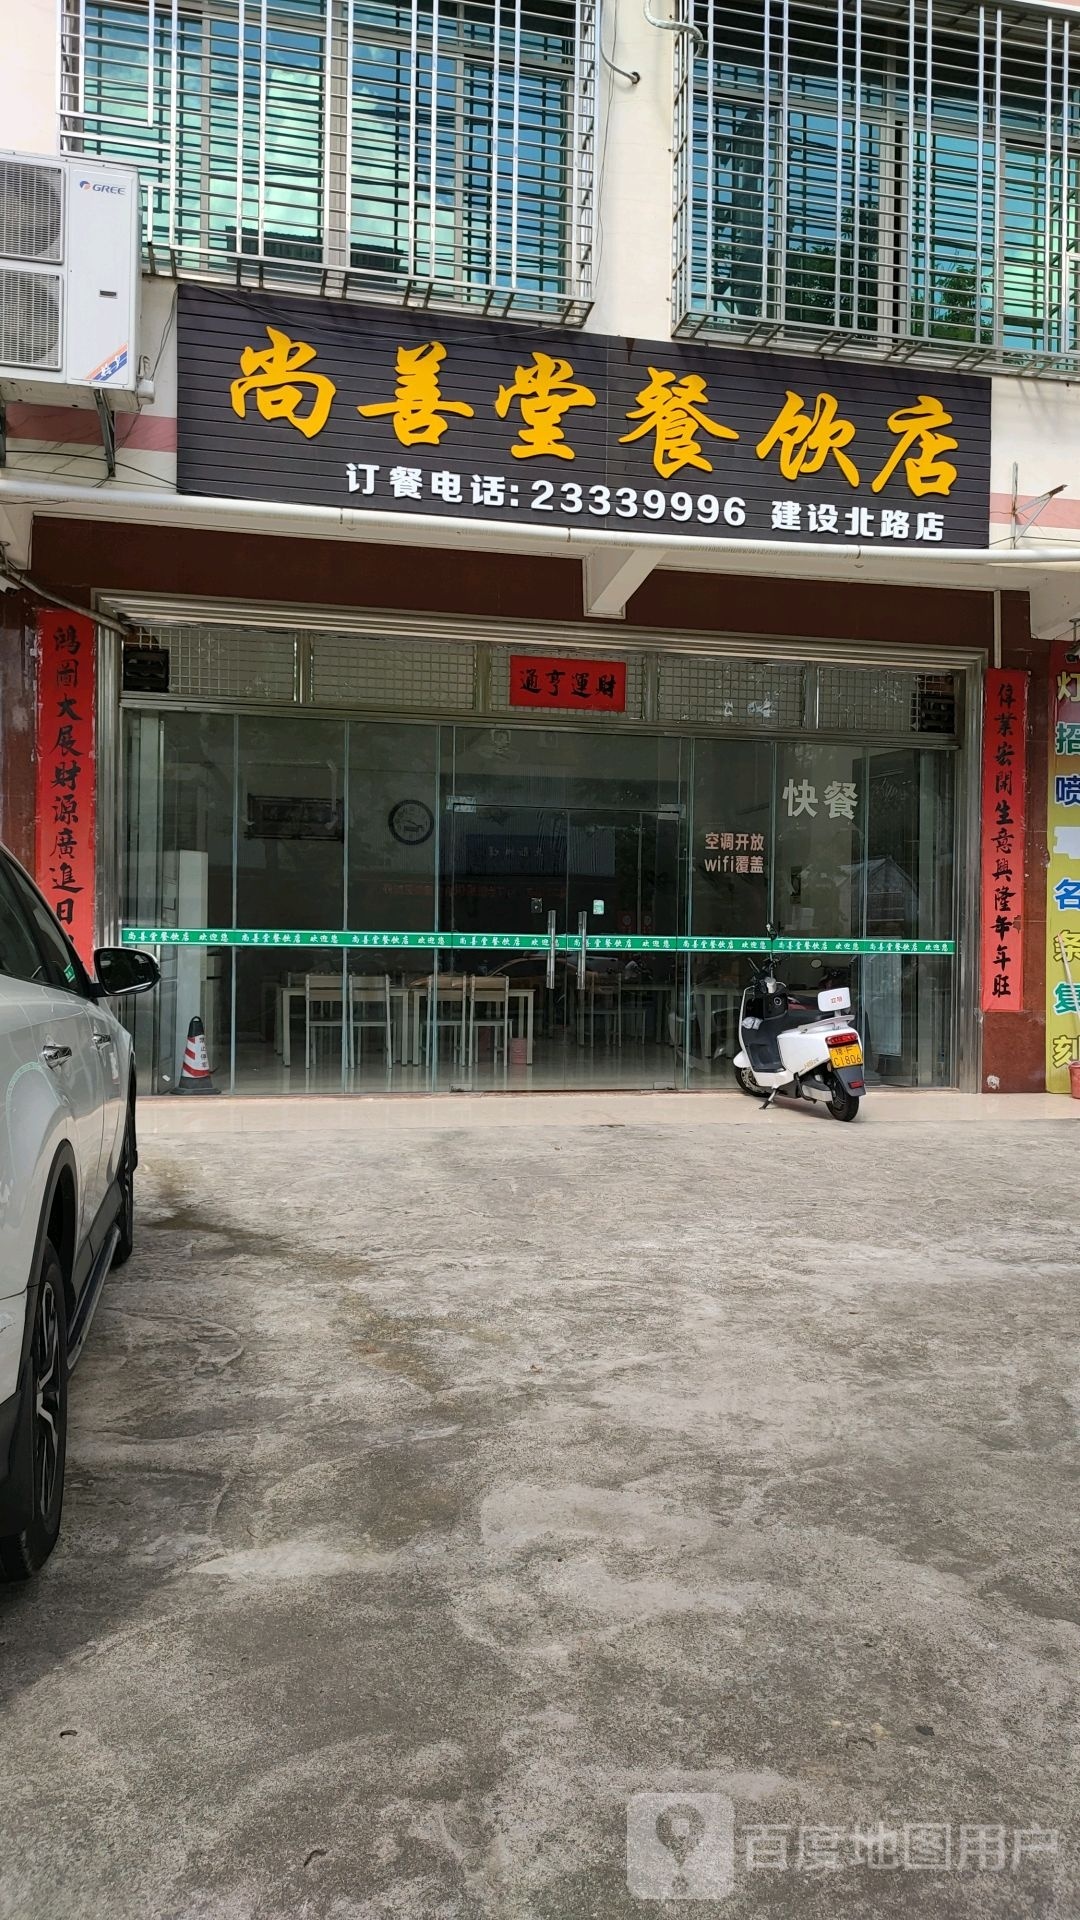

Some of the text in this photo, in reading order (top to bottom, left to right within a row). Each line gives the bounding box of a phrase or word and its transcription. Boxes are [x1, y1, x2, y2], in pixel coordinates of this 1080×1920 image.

[92, 183, 126, 196] GREE
[230, 325, 958, 497] 尚善堂餐饮店
[771, 500, 945, 542] 建设北路店
[1055, 721, 1080, 754] 招
[50, 625, 85, 943] 鴻圖大展財源廣進日
[782, 779, 858, 820] 快餐
[1055, 775, 1080, 806] 喷
[705, 832, 764, 851] 空调开放
[704, 855, 764, 874] wifi覆盖
[1054, 877, 1080, 910] 名
